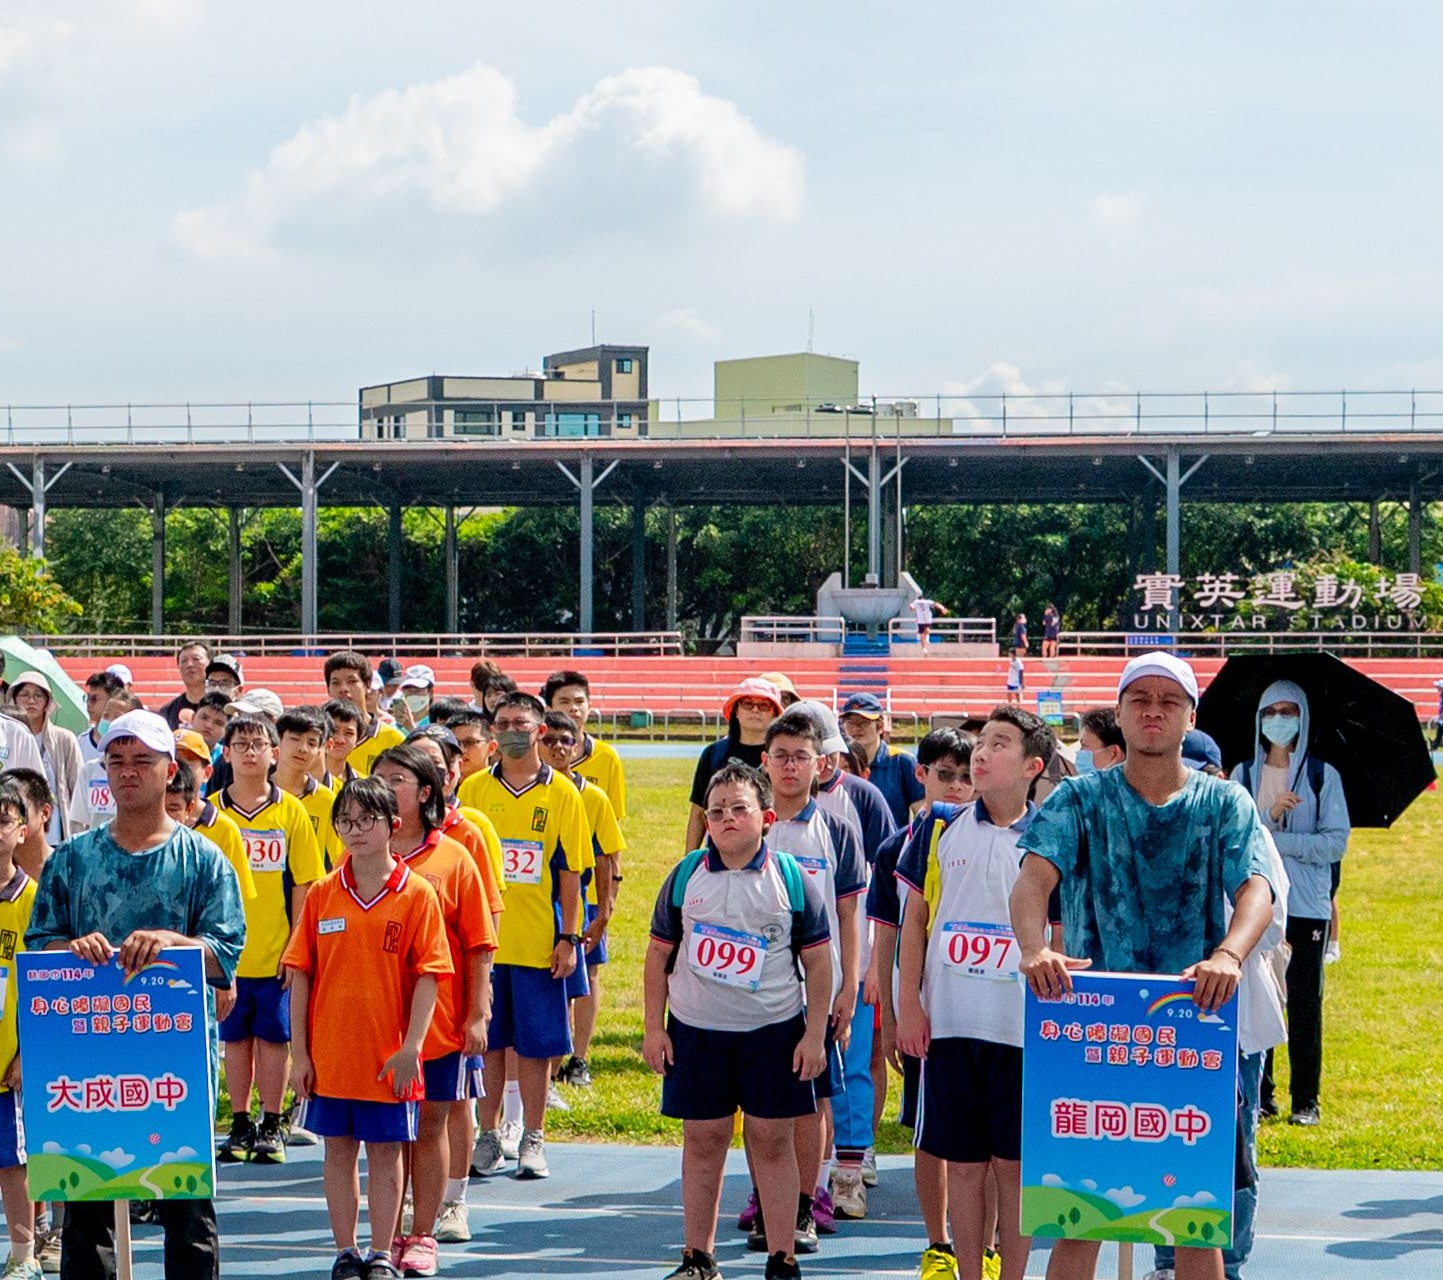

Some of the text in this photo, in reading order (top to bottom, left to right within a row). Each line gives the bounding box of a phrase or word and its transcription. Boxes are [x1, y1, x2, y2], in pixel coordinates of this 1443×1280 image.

[1134, 614, 1427, 629] UNIXTAR STADIUM
[696, 937, 756, 975] 099
[948, 933, 1012, 969] 097
[140, 976, 164, 986] 9.20
[31, 994, 152, 1016] 身心障礙國民
[1166, 1008, 1193, 1019] 9.20
[1040, 1019, 1177, 1045] 身心障礙國民
[46, 1072, 188, 1113] 大成國中
[1051, 1097, 1211, 1146] 龍岡國中
